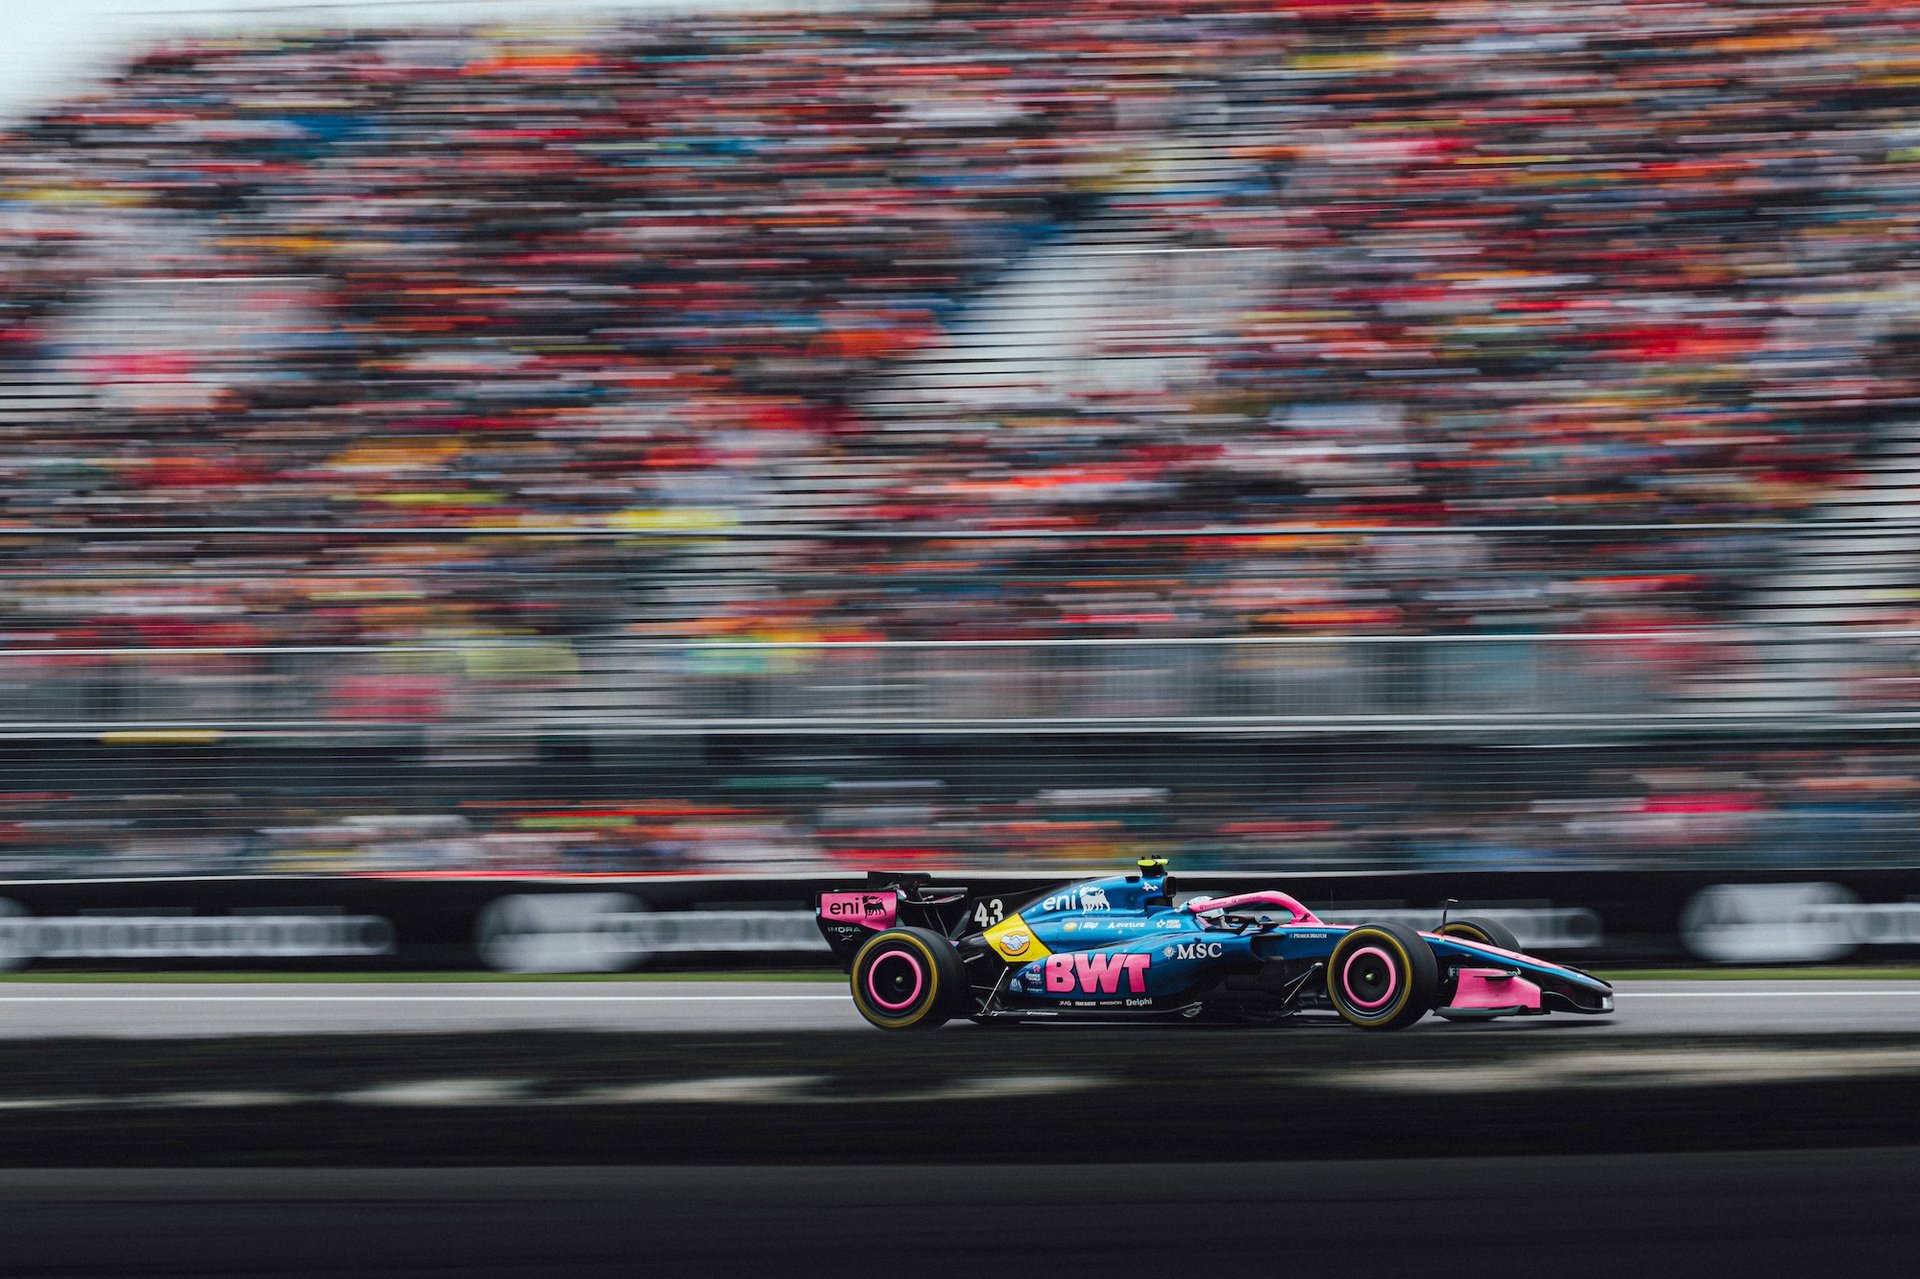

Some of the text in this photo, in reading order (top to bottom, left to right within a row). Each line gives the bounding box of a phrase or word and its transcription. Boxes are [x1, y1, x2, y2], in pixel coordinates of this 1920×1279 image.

[829, 897, 860, 915] eni
[1043, 889, 1077, 911] eni
[974, 899, 1004, 927] 43
[1177, 942, 1223, 960] MSC
[1045, 953, 1151, 994] BWT
[1126, 997, 1153, 1007] Delphi
